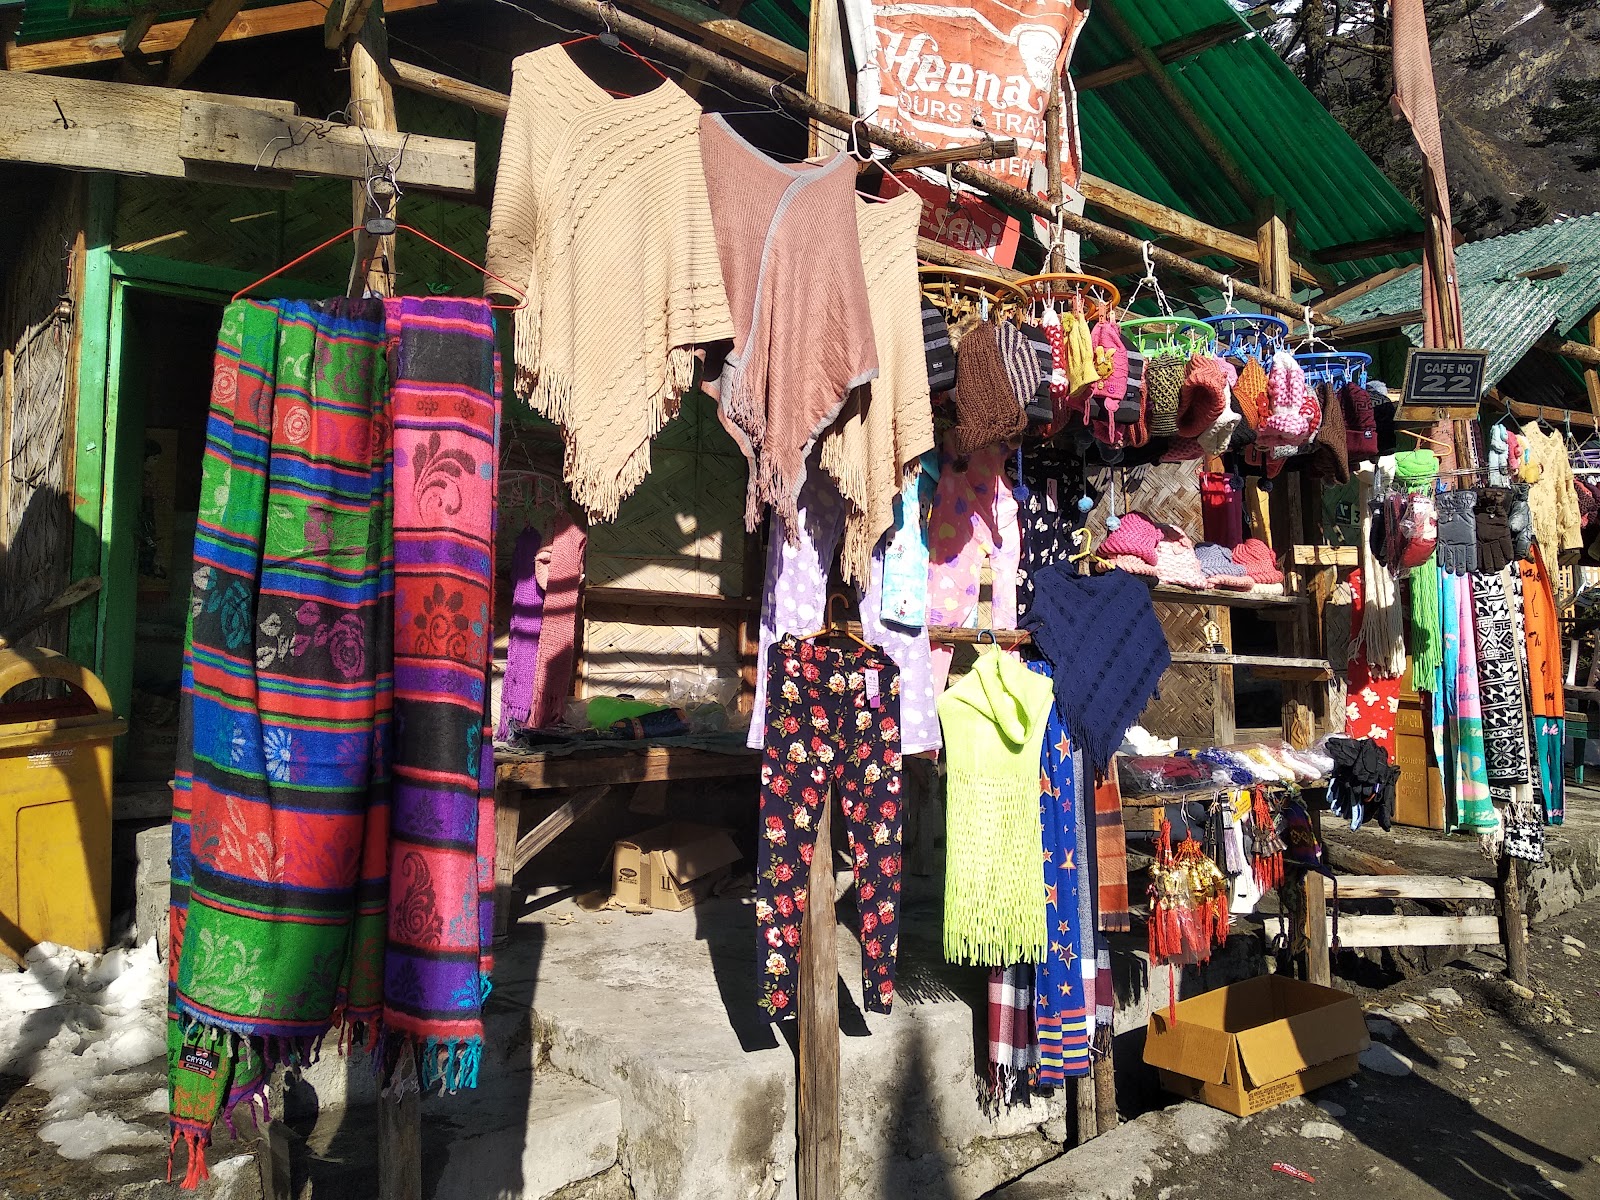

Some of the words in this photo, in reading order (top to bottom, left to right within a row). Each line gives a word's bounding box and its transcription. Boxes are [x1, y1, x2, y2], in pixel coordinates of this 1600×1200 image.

[866, 25, 1043, 114] Heena
[1424, 363, 1455, 374] CAFE
[1457, 363, 1474, 374] NO
[1420, 375, 1472, 393] 22
[185, 1054, 213, 1069] CRYSTAL
